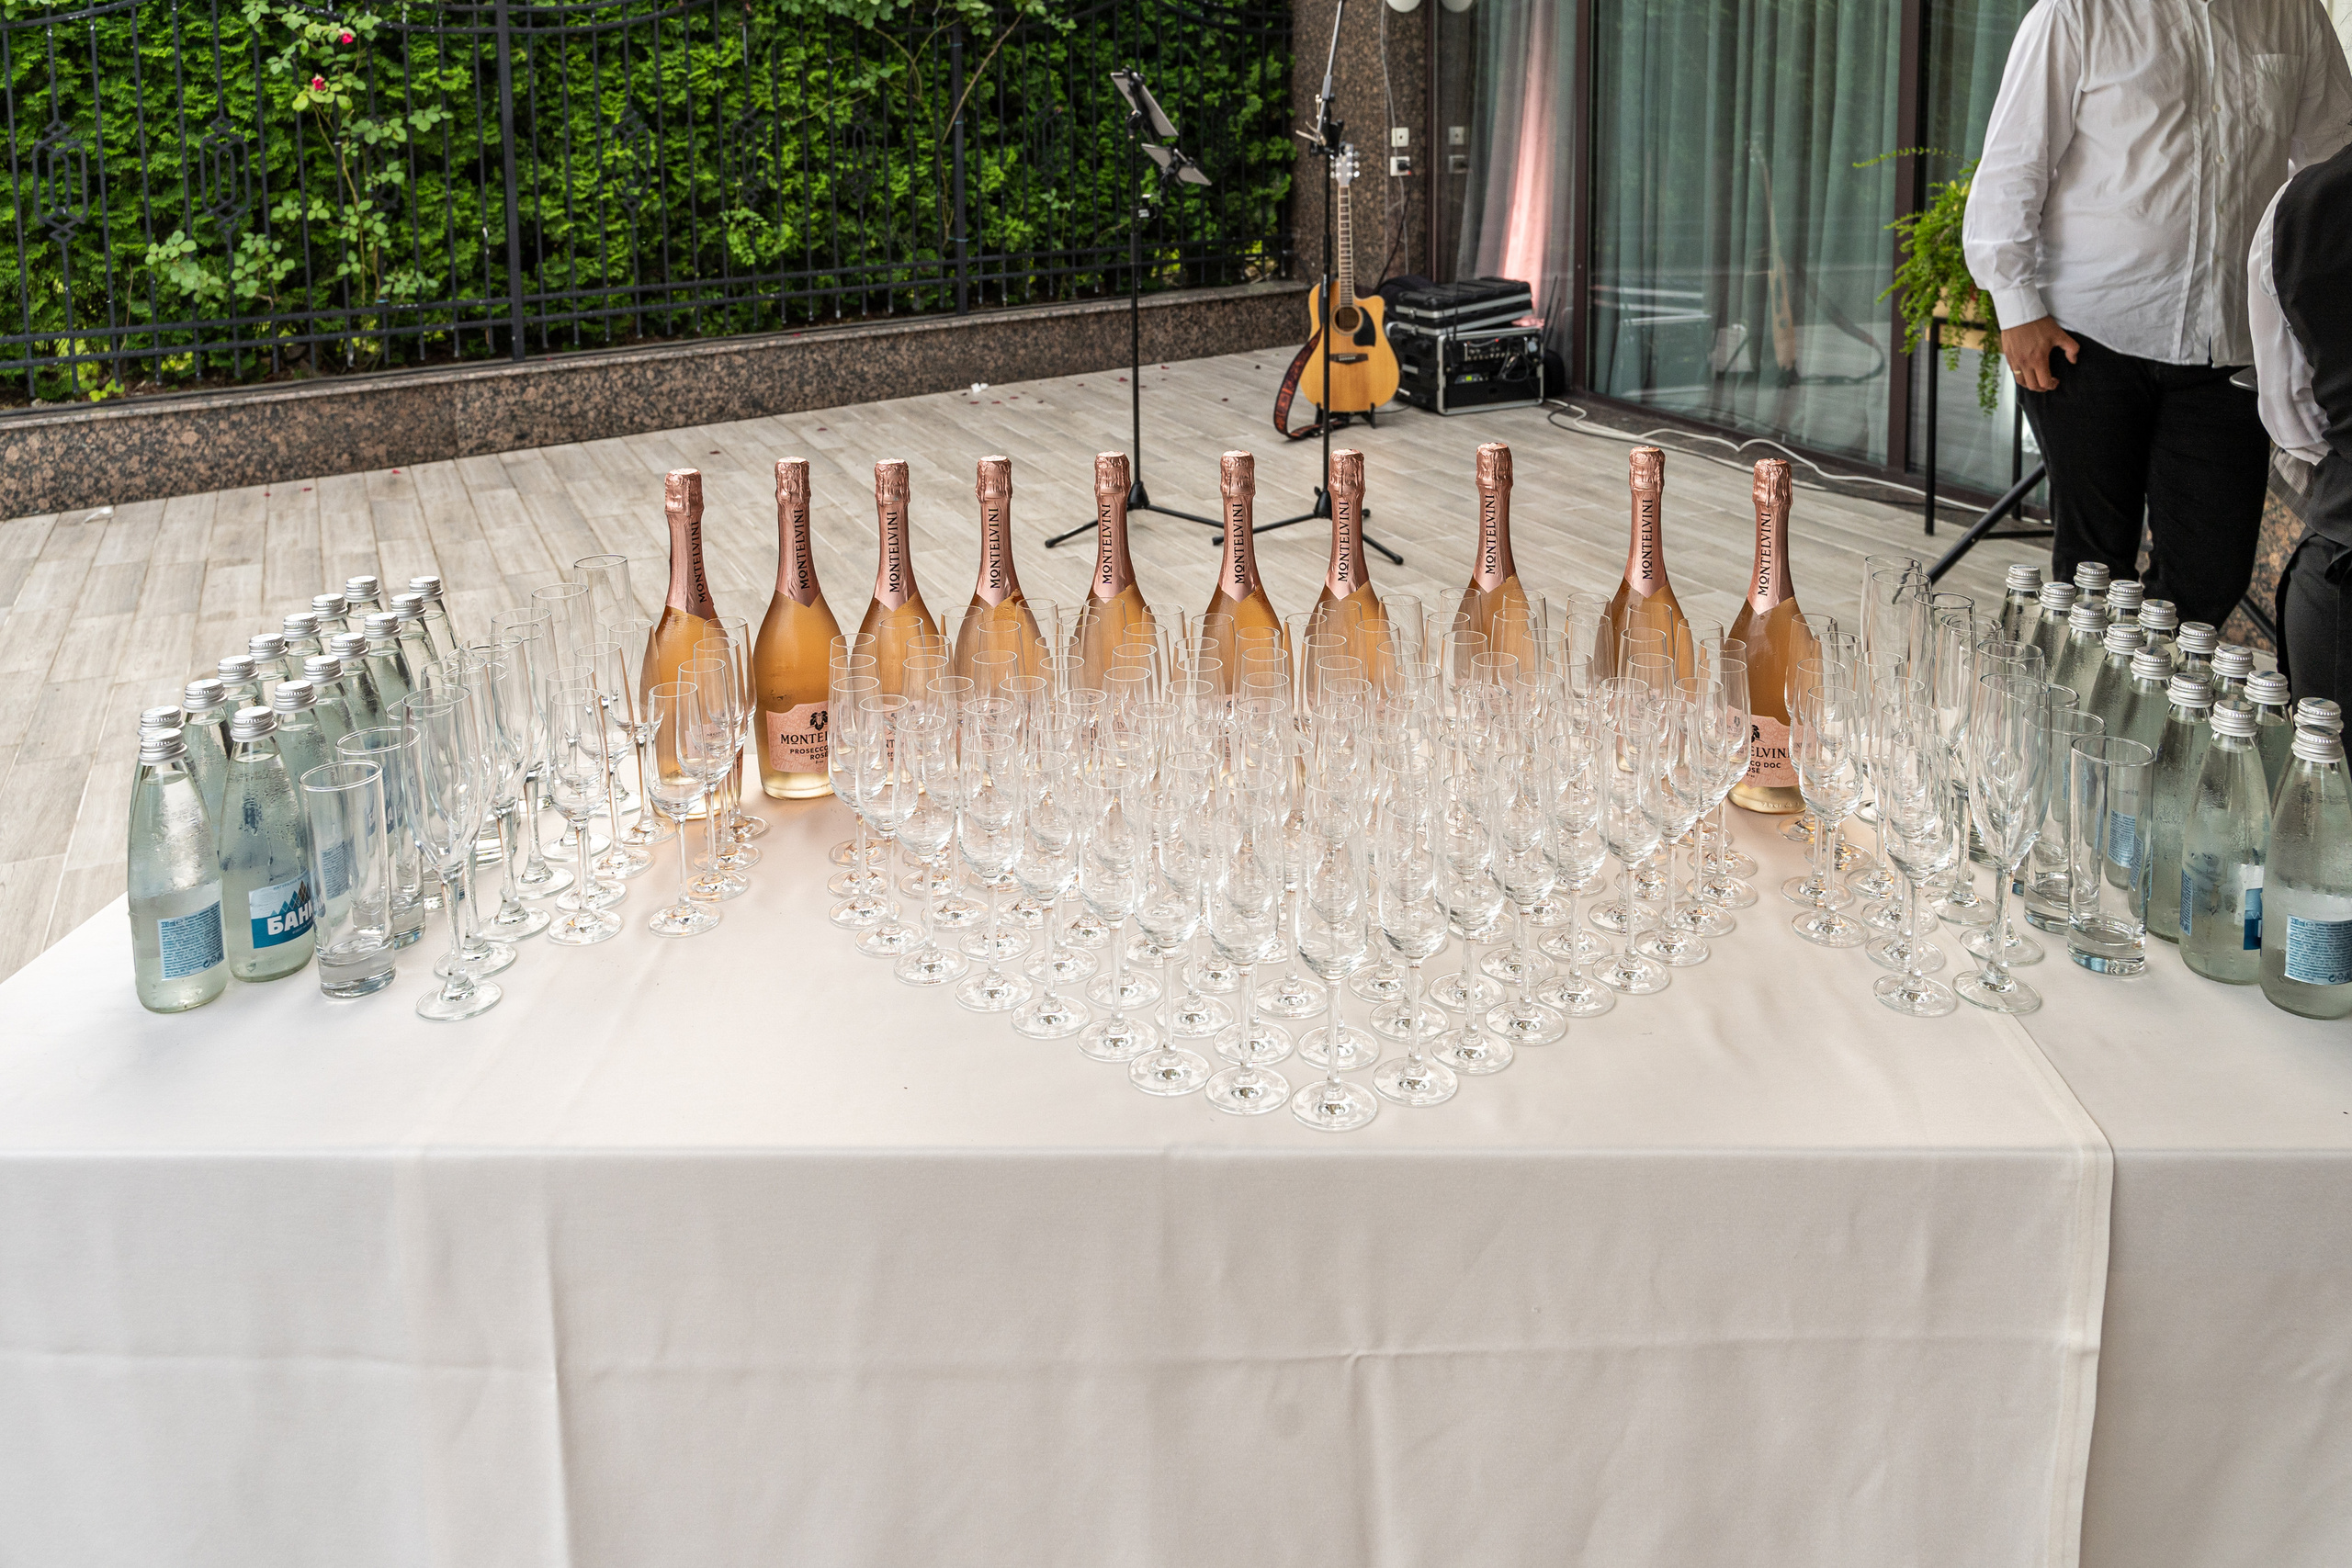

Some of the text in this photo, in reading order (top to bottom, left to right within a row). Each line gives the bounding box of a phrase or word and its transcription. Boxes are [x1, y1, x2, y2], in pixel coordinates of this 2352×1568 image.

[691, 521, 707, 604] MONTELVINI
[794, 509, 810, 590] MONTELVINI
[887, 511, 900, 592] MONTELVINI
[989, 508, 1001, 589] MONTELVINI
[1102, 503, 1113, 584] MONTELVINI
[1232, 503, 1245, 584] MONTELVINI
[1338, 502, 1350, 582] MONTELVINI
[1485, 494, 1497, 575] MONTELVINI
[1641, 499, 1653, 580] MONTELVINI
[1758, 513, 1771, 597] MONTELVINI
